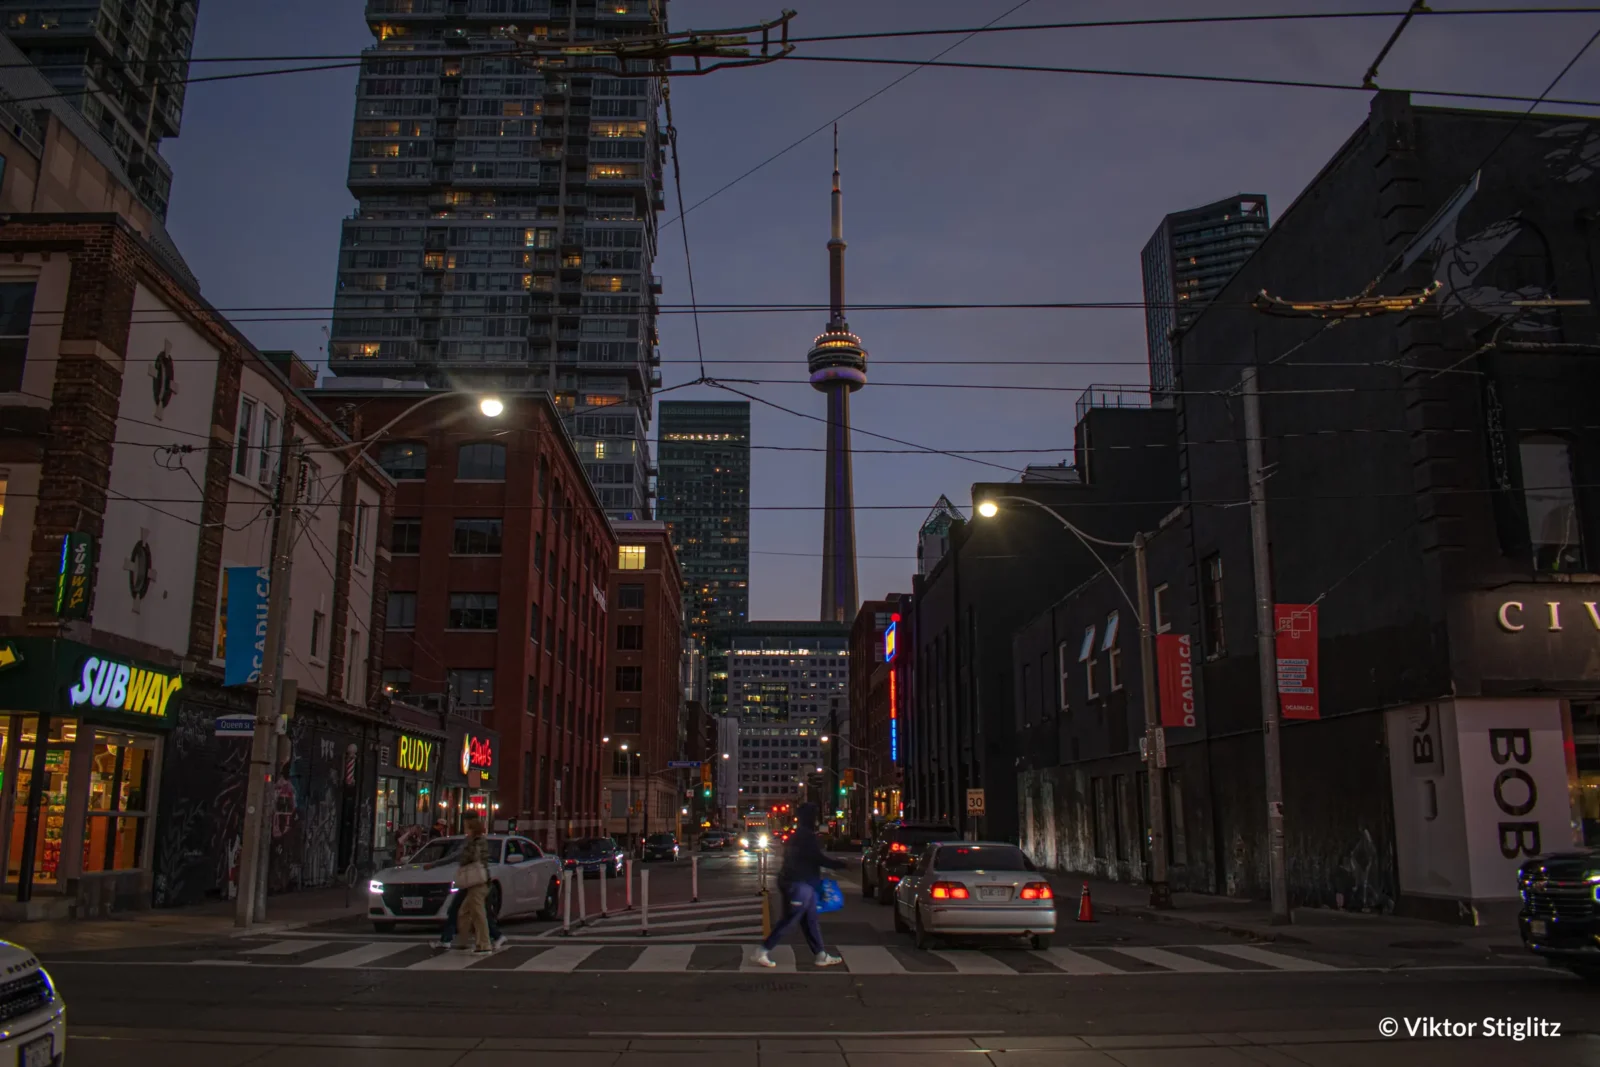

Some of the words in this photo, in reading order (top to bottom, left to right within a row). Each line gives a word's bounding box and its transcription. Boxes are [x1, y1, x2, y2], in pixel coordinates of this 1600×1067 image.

[69, 543, 87, 609] SUBWAY
[69, 656, 182, 718] SUBWAY
[1178, 634, 1196, 728] OCADU.CA
[221, 720, 243, 729] Queen
[399, 735, 432, 773] RUDY
[969, 797, 983, 807] 30
[1489, 728, 1542, 860] BOB
